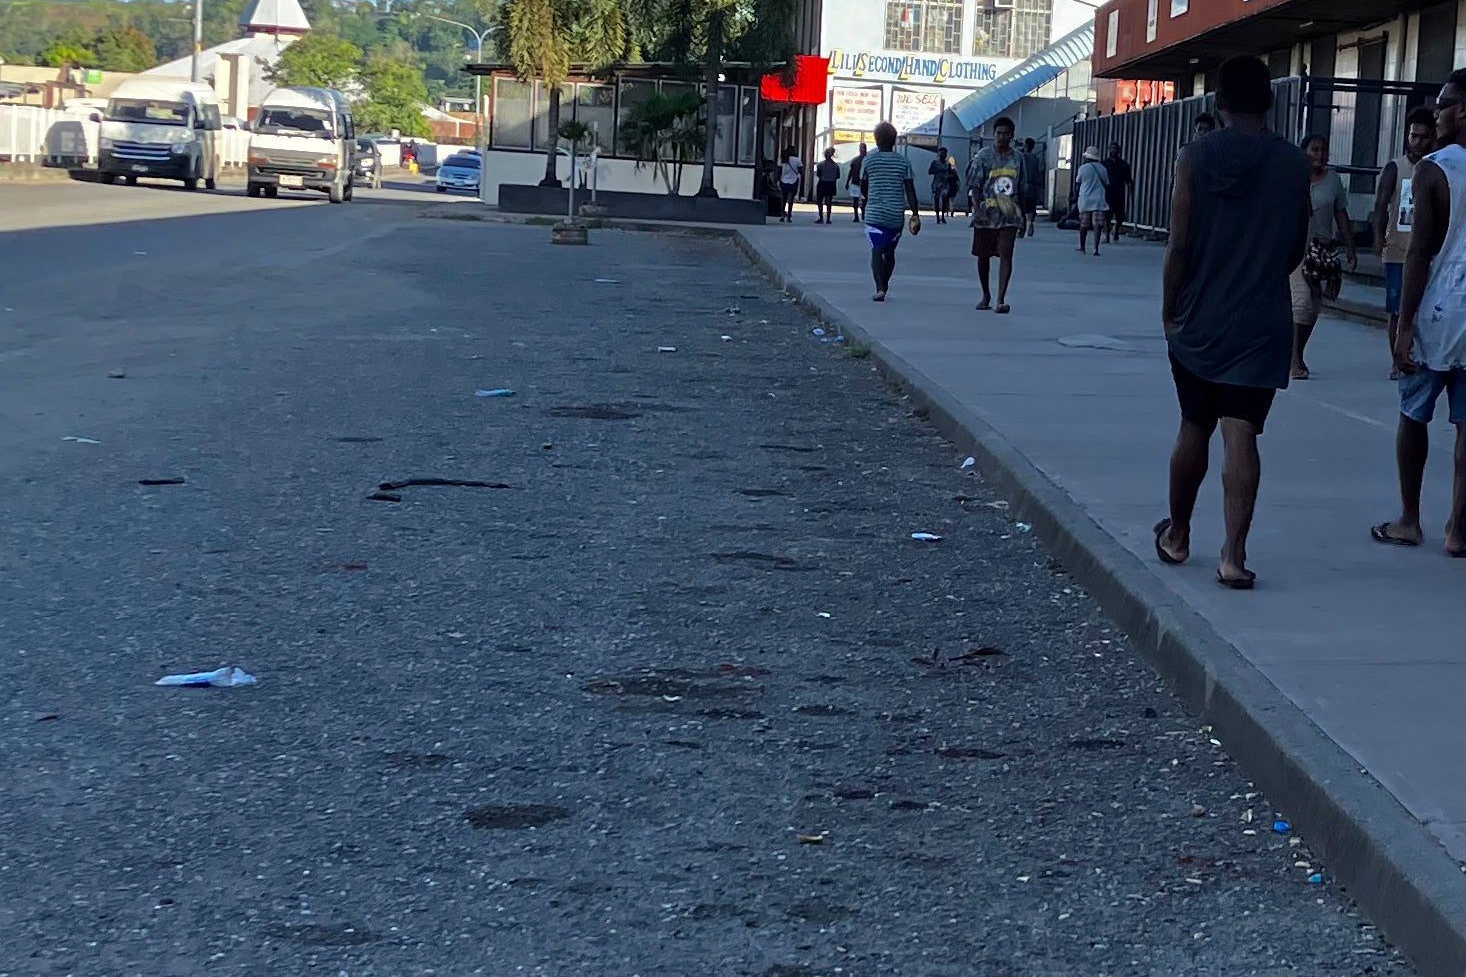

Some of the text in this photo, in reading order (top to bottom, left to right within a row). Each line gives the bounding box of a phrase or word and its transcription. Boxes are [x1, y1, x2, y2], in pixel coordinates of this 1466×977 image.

[858, 52, 900, 74] SECOND
[904, 56, 937, 77] HAND
[939, 58, 997, 80] CLOTHING
